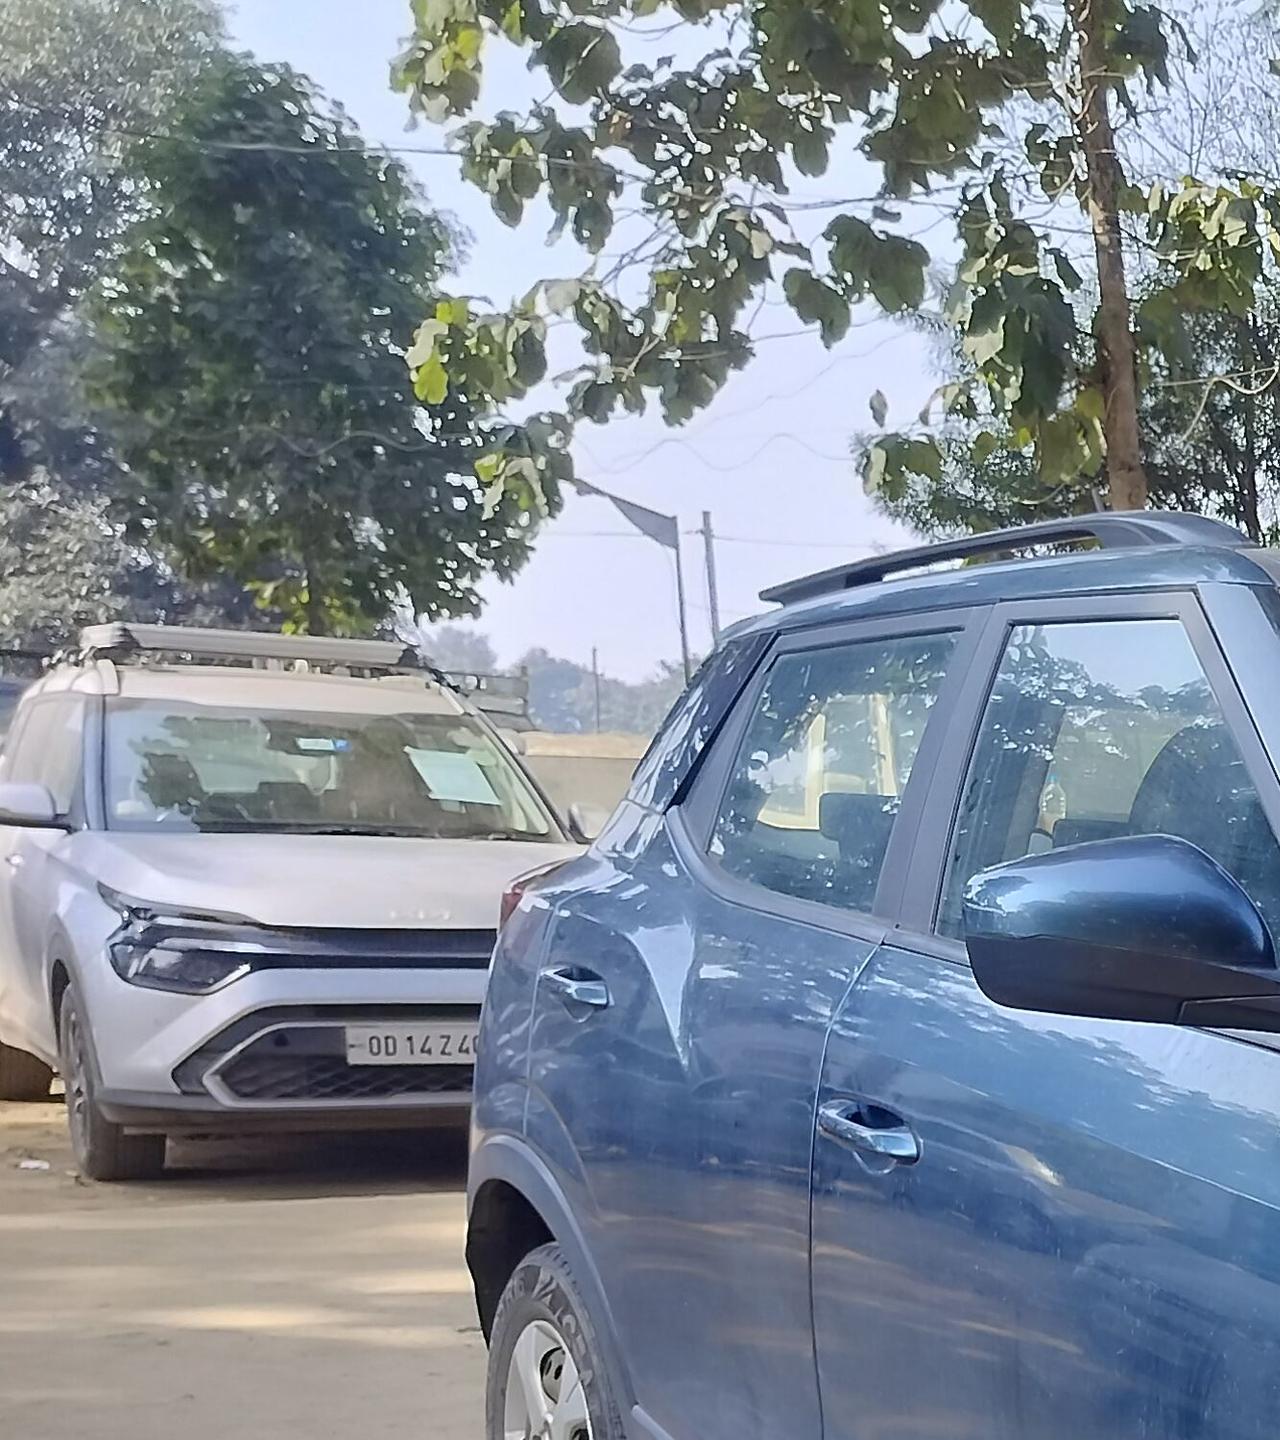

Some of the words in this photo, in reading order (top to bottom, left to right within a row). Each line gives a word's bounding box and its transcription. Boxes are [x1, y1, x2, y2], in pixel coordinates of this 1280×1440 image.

[368, 1035, 397, 1057] OD
[406, 1035, 433, 1056] 14
[439, 1035, 452, 1056] Z
